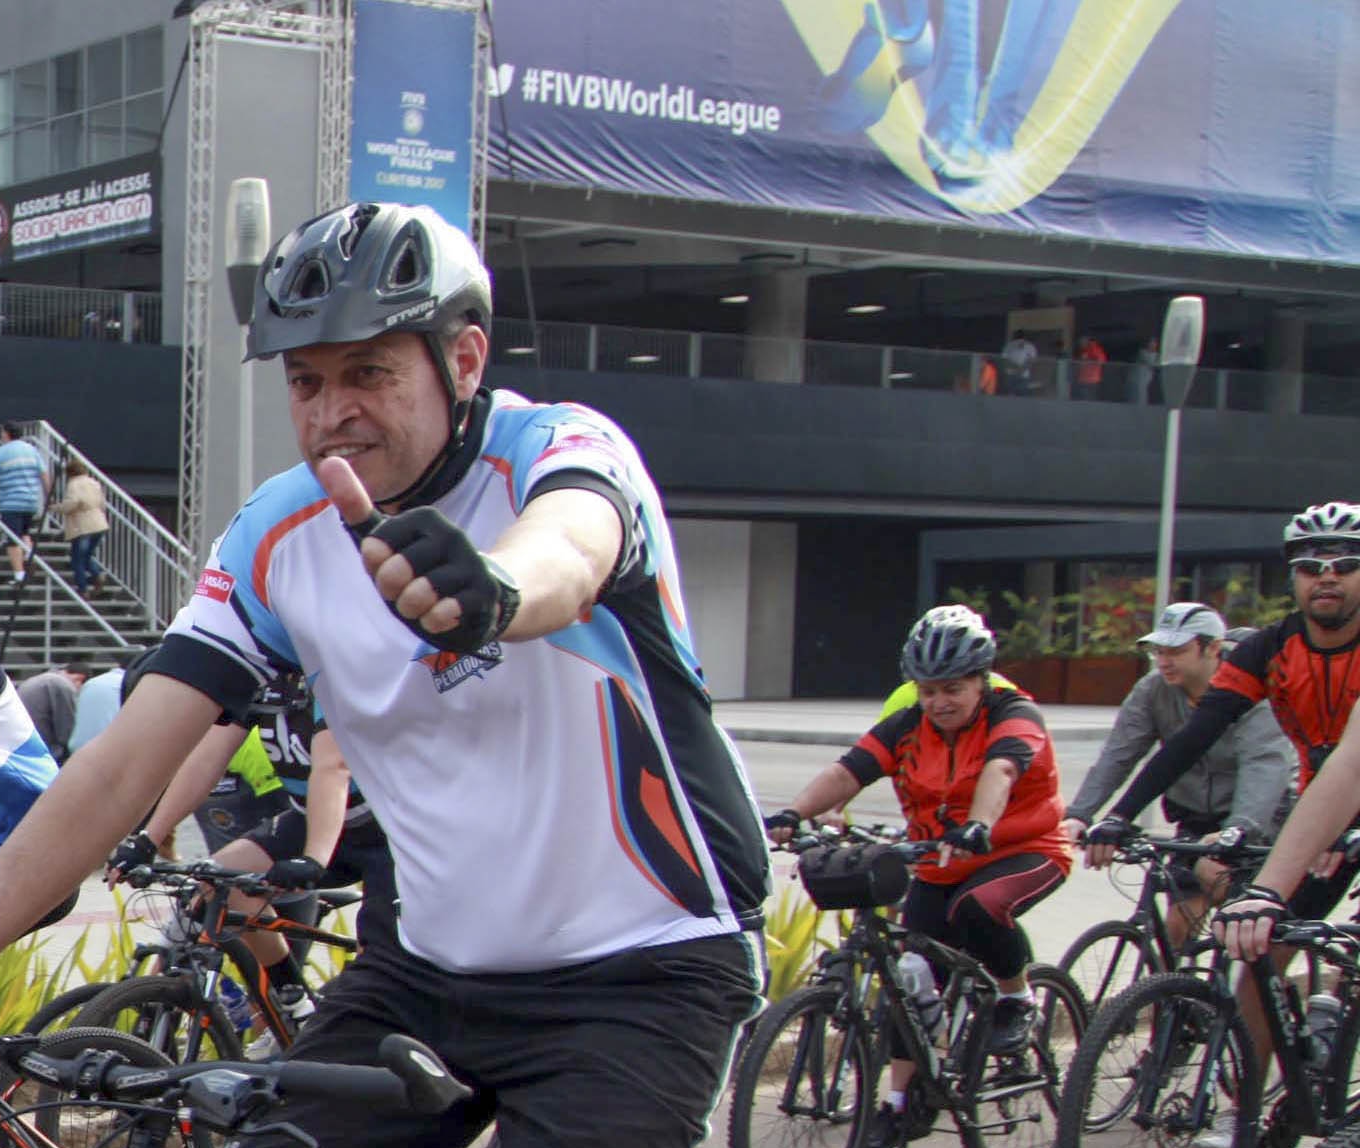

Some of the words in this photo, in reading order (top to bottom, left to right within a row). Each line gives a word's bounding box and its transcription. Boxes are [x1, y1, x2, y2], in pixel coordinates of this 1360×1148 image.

[521, 67, 781, 136] #FIVBWorldLeague
[366, 141, 409, 157] WORLD
[411, 146, 457, 163] LEAGUE
[390, 156, 432, 172] FINALS
[13, 188, 80, 220] ASSOCIE-SE
[386, 299, 435, 327] BTWIN
